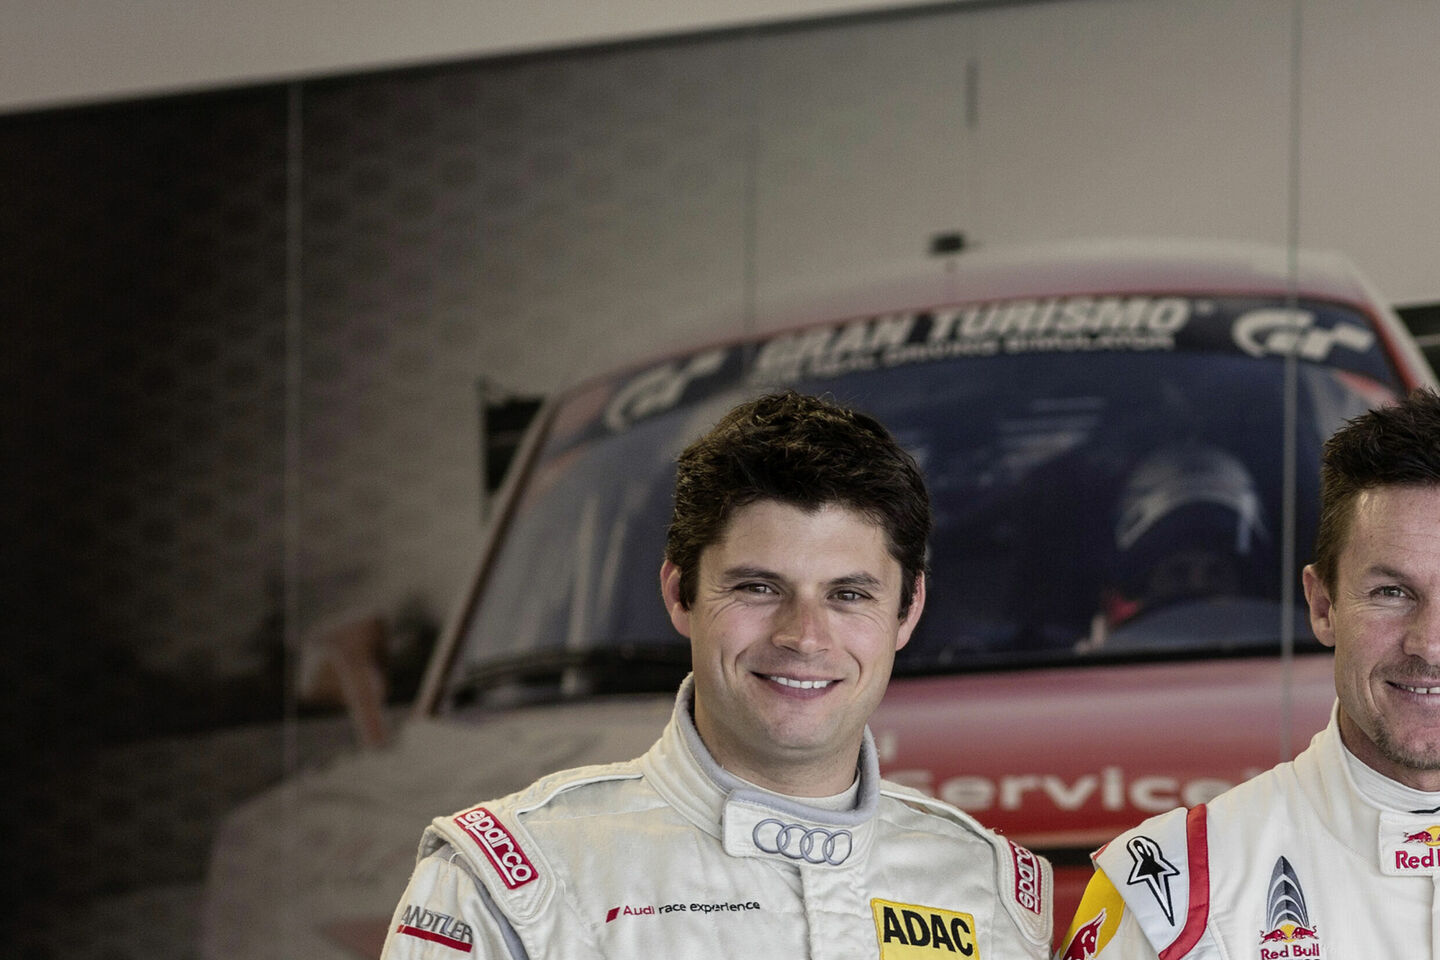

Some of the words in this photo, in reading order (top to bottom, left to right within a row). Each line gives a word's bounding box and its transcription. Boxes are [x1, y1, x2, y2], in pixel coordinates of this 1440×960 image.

[1395, 848, 1434, 869] Red
[623, 905, 655, 916] Audi
[658, 902, 687, 914] race
[689, 901, 761, 914] experience
[402, 904, 473, 944] ANDTLER
[883, 906, 974, 957] ADAC
[1260, 944, 1289, 960] Red
[1293, 943, 1321, 957] Bull
